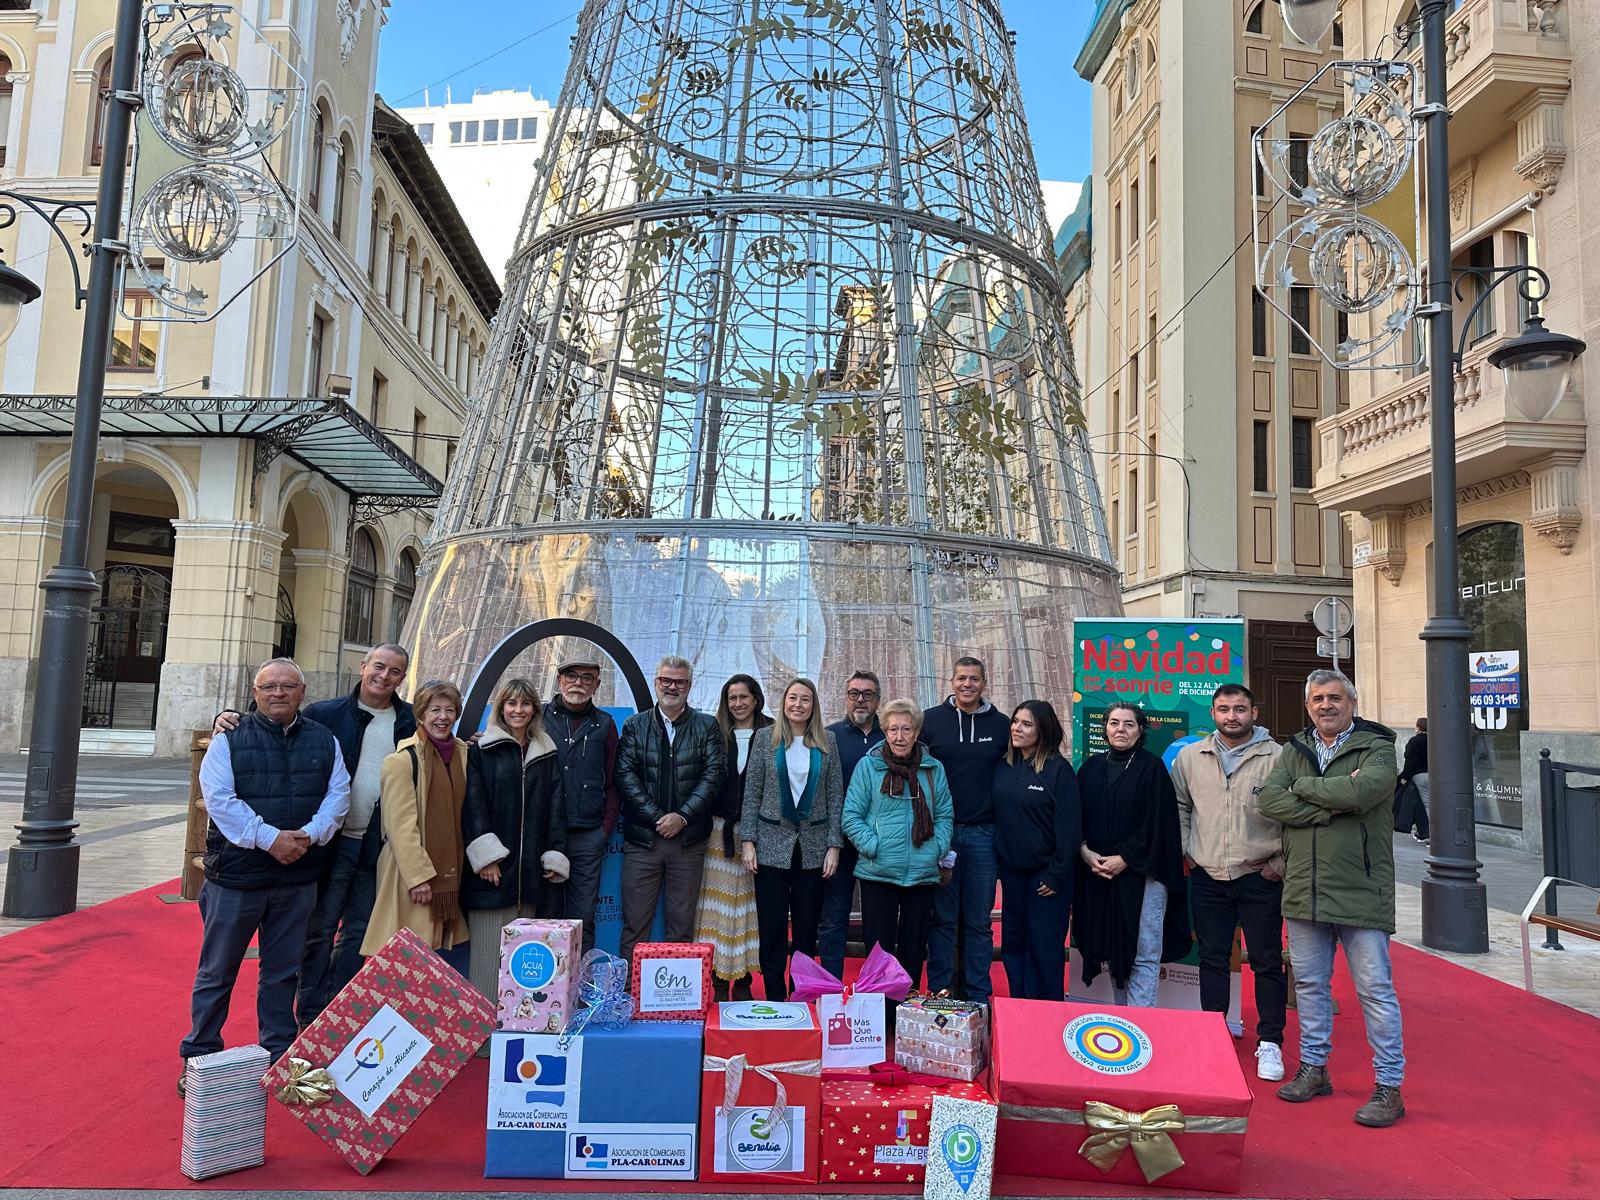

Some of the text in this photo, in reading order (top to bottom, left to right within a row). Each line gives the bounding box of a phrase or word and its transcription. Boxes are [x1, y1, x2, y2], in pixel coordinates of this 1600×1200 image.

[1084, 639, 1231, 675] Navidad
[1470, 682, 1519, 693] ISPONIBLE
[1483, 694, 1494, 705] 09
[1495, 694, 1505, 705] 31
[1476, 783, 1483, 791] &
[595, 896, 614, 904] NTE
[521, 961, 544, 970] ACUA
[854, 1035, 882, 1043] Centro
[1108, 1017, 1149, 1051] COMERCIANTES
[385, 1066, 394, 1076] de
[394, 1040, 418, 1068] Alicante
[1072, 1050, 1143, 1073] ZONA QUINTANA
[526, 1111, 533, 1119] DE
[533, 1109, 568, 1120] COMERCIANTES
[497, 1121, 568, 1129] PLA-CAROLINAS
[642, 1149, 649, 1157] DE
[649, 1148, 686, 1157] COMERCIANTES
[876, 1145, 928, 1161] Plaza Arge
